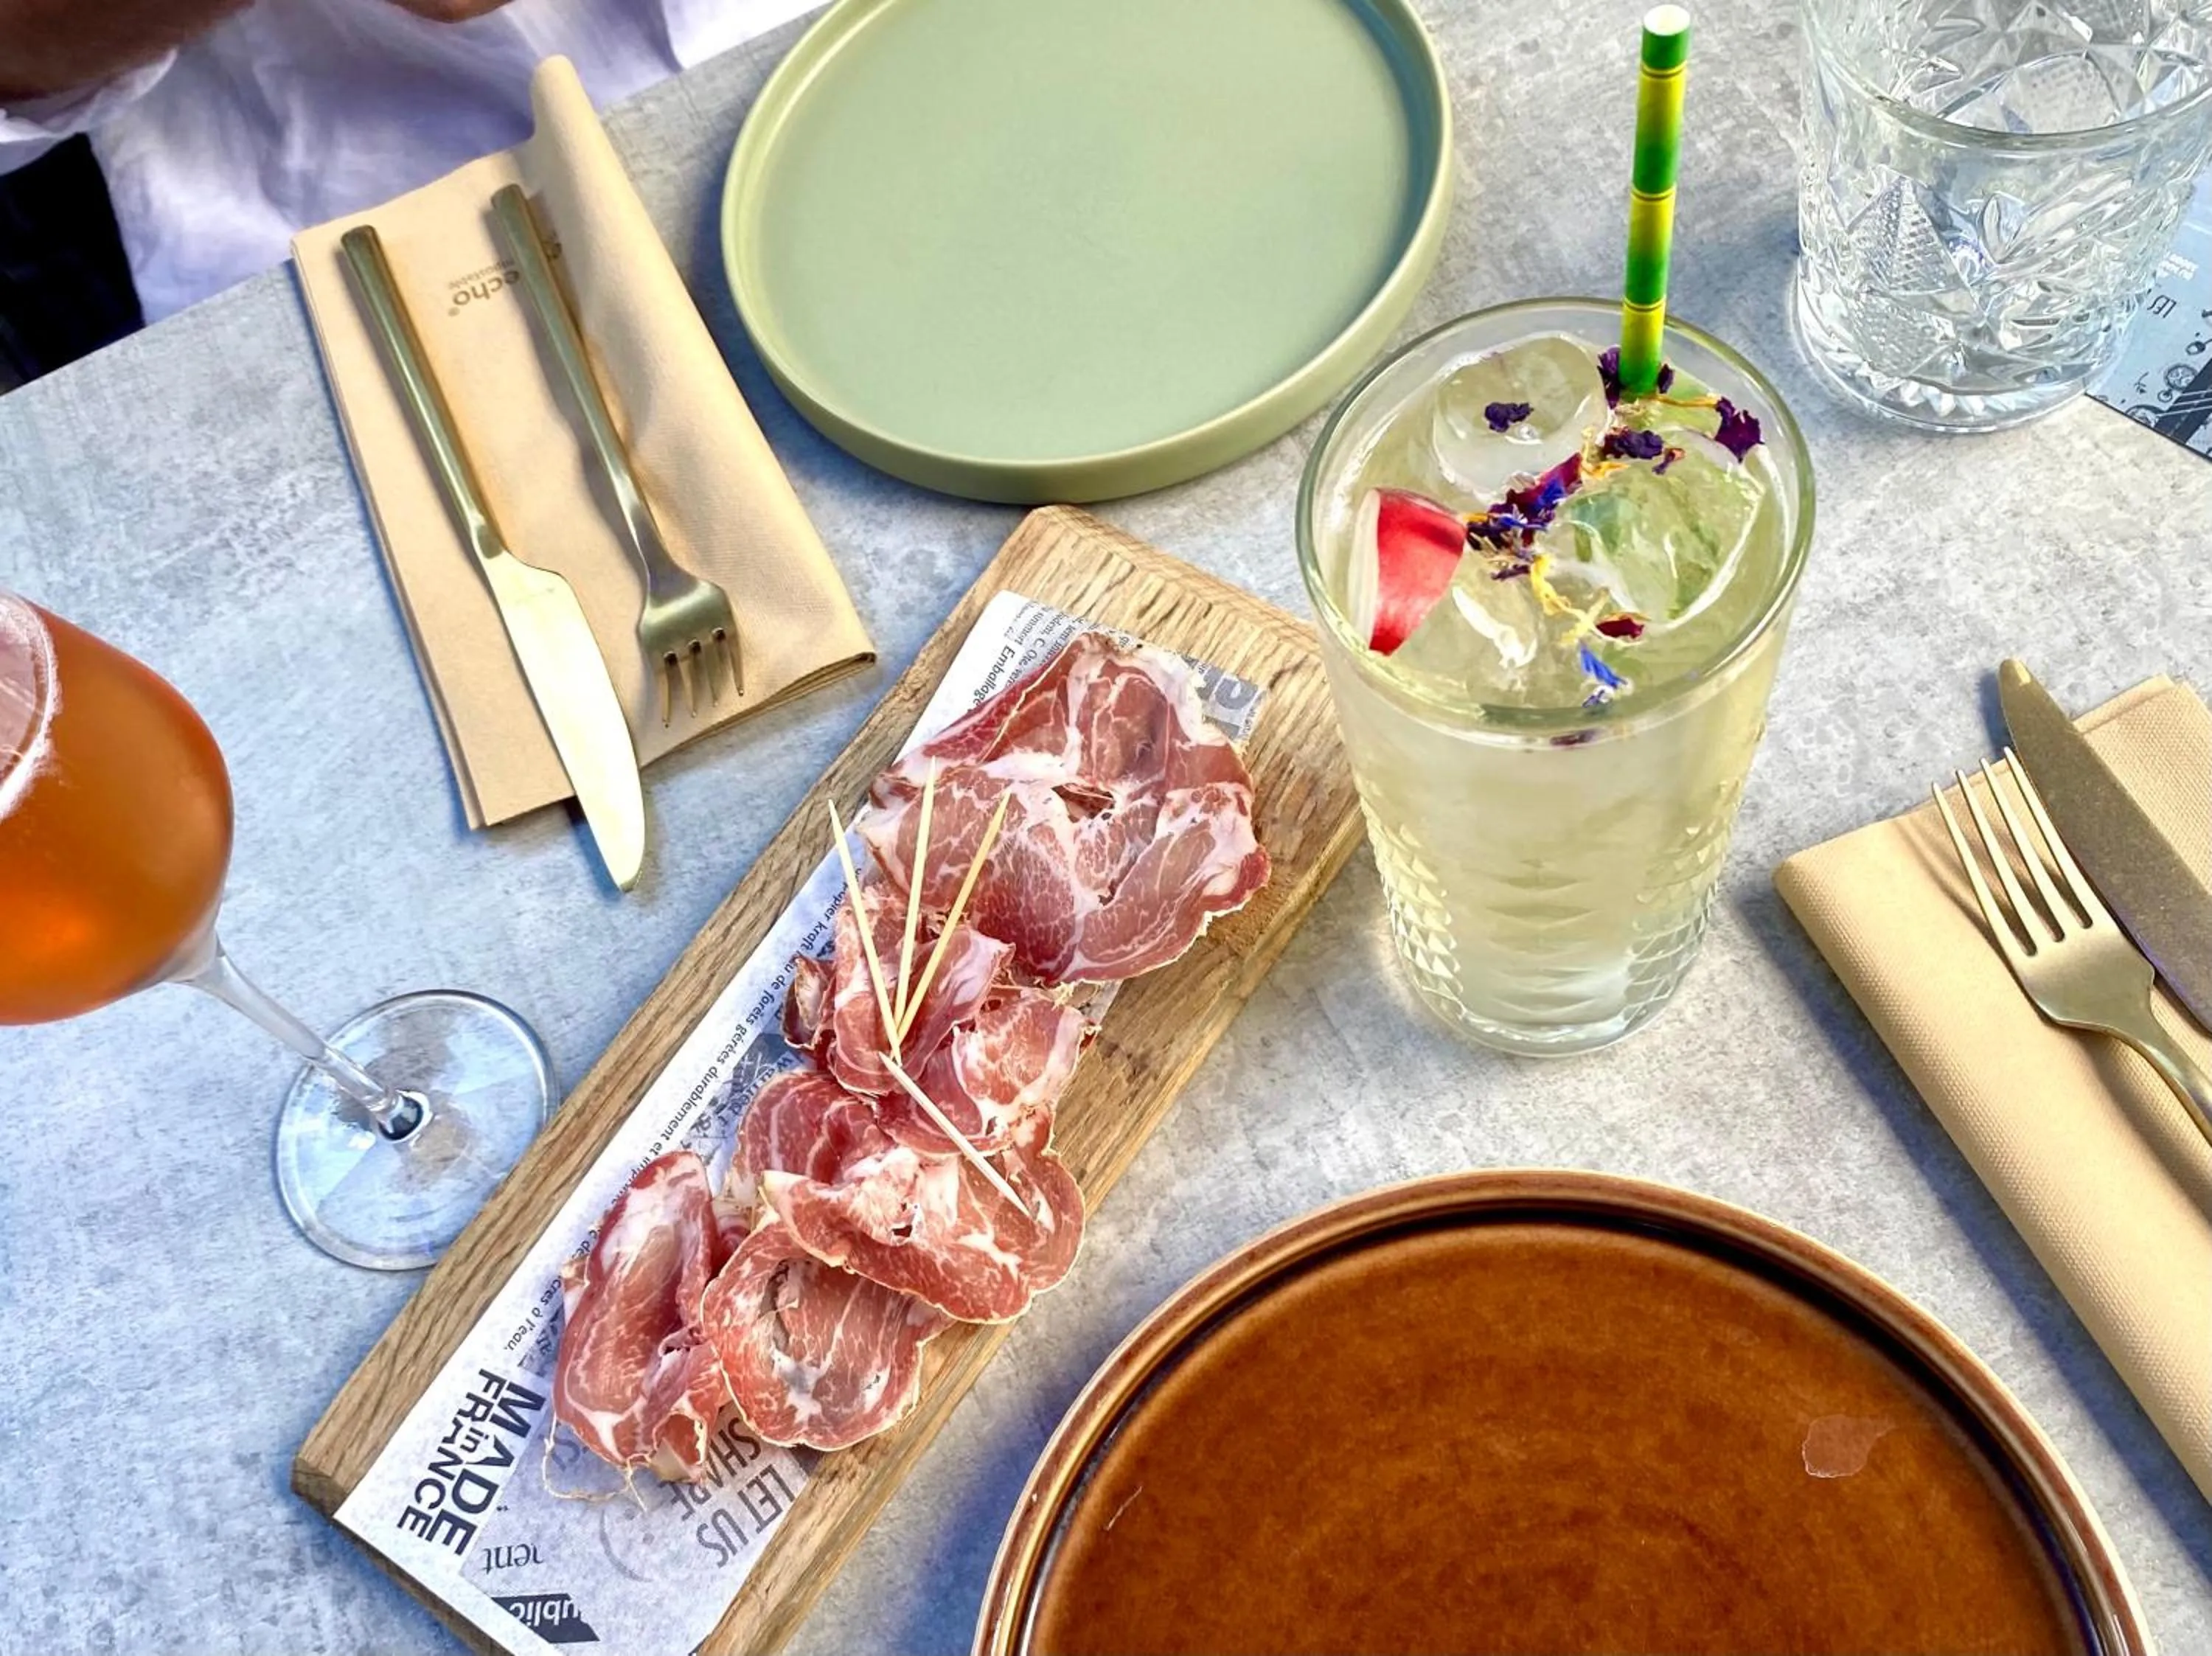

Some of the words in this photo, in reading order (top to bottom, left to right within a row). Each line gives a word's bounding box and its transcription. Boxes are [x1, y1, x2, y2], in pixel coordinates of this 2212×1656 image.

[973, 644, 1015, 706] Emballage
[800, 921, 829, 951] kraft
[771, 974, 785, 990] de
[745, 989, 775, 1026] forêts
[717, 1023, 748, 1064] gérées
[661, 1065, 717, 1141] durablement
[650, 1141, 663, 1156] et
[397, 1368, 507, 1538] FRANCE
[459, 1427, 490, 1453] in
[425, 1381, 546, 1556] MADE
[737, 1464, 796, 1534] LET
[696, 1509, 749, 1569] US
[509, 1598, 581, 1627] ublic
